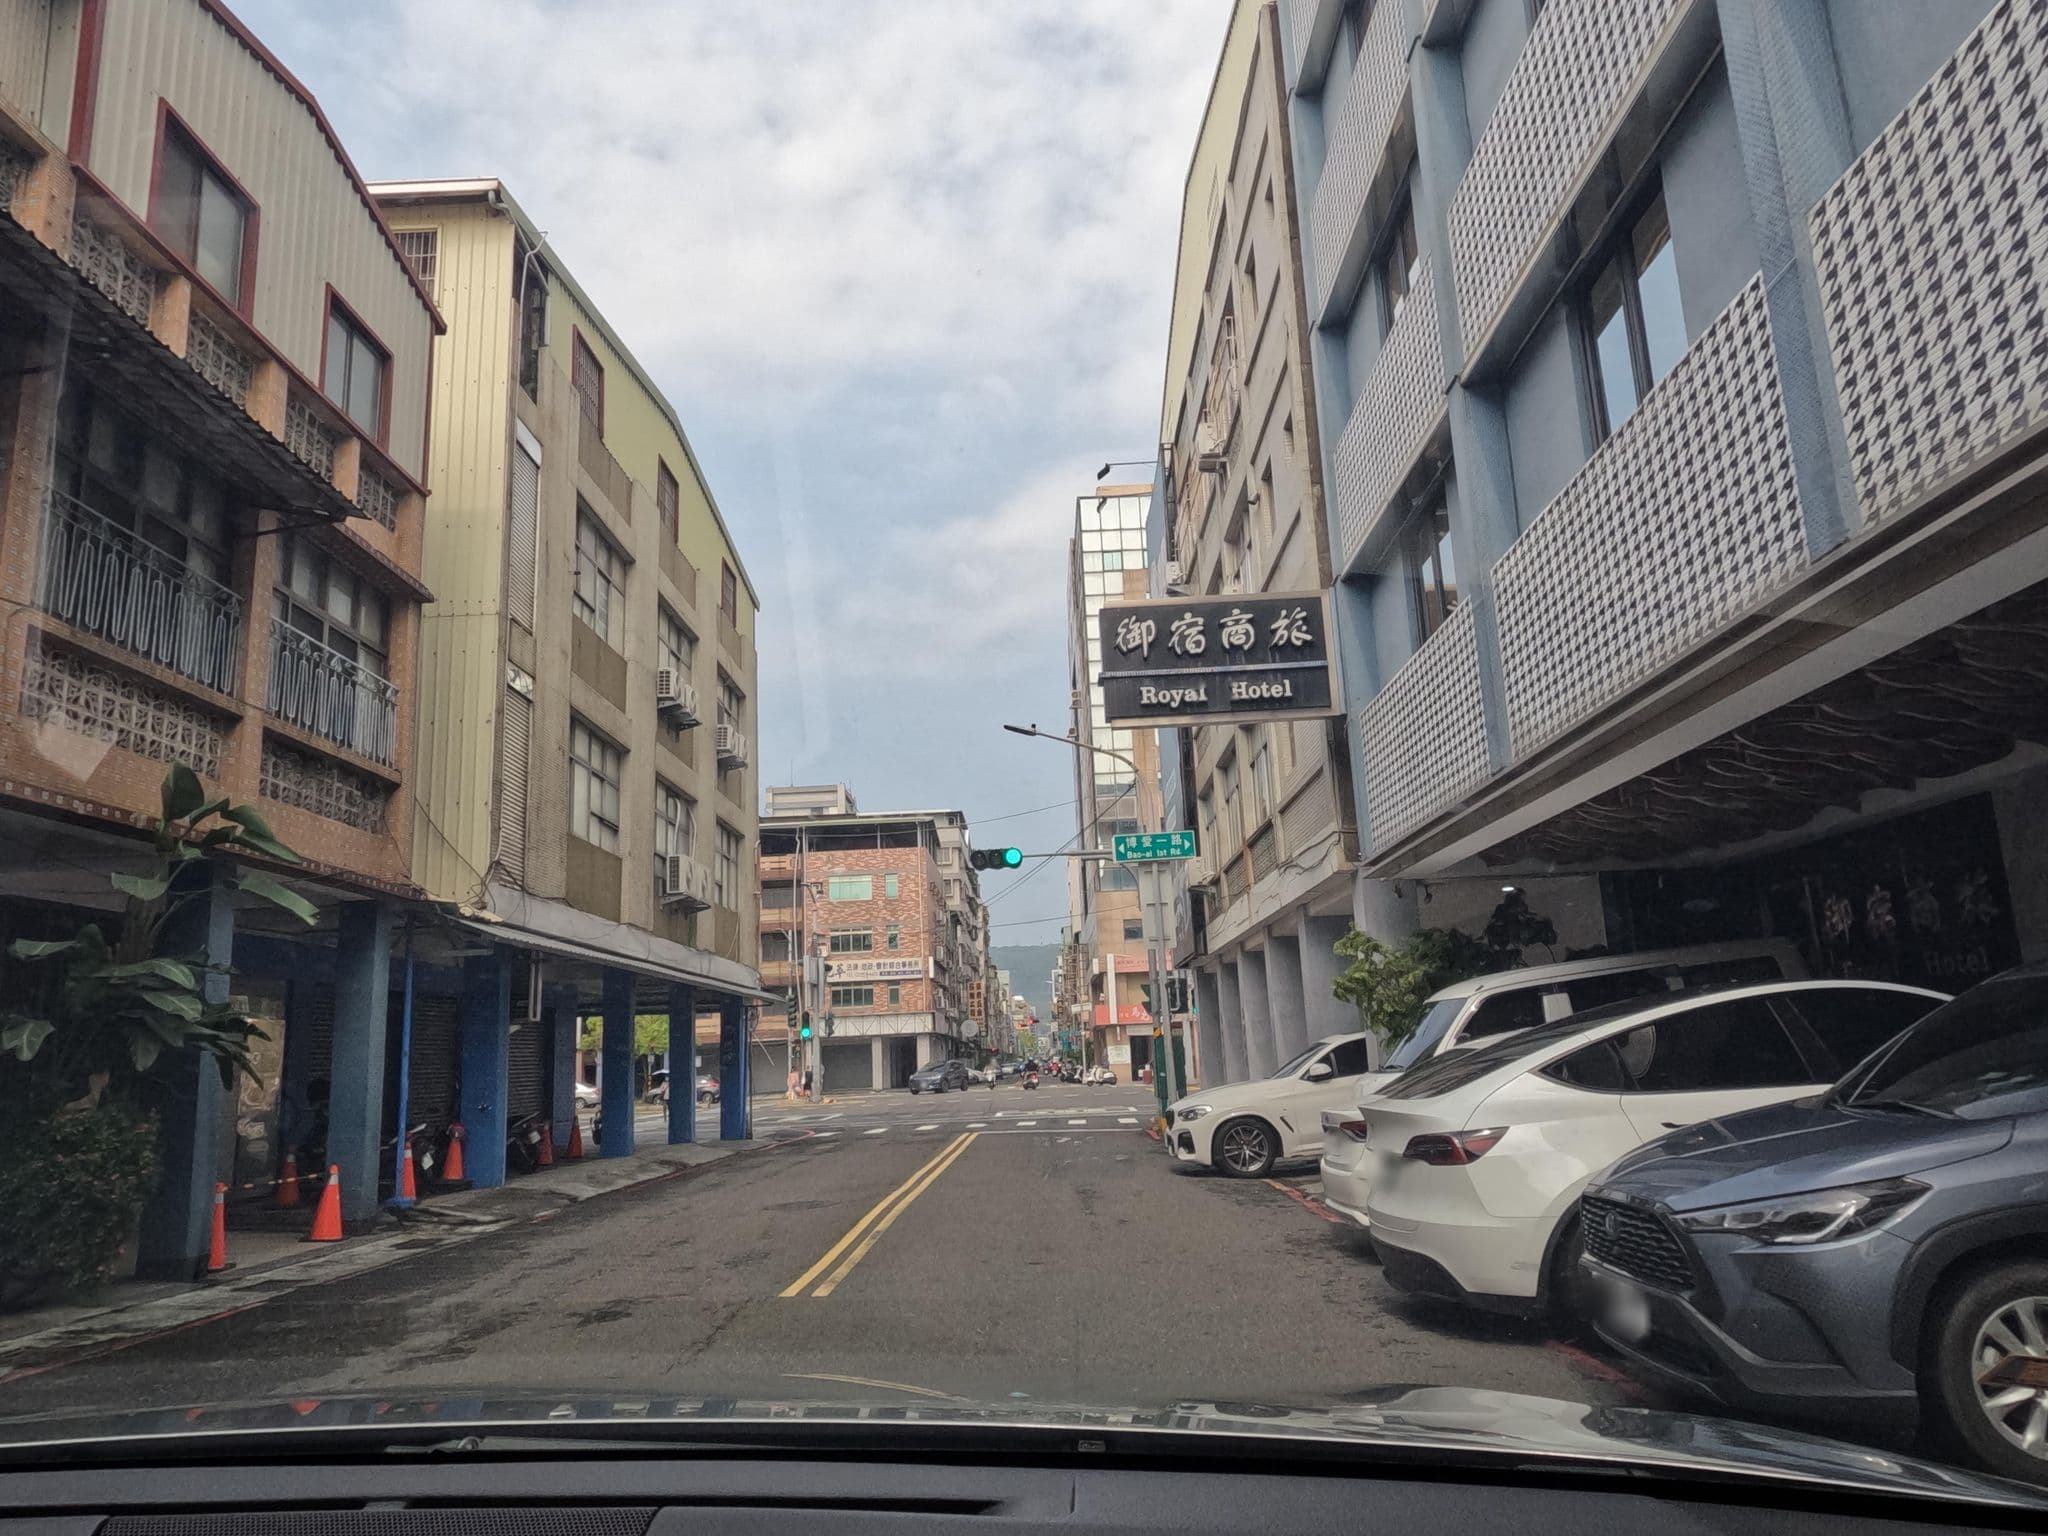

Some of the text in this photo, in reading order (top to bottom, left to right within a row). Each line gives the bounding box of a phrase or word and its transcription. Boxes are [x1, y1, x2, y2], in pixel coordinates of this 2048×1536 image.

[1115, 606, 1313, 658] 御宿商旅
[1140, 679, 1293, 708] Royal Hotel
[1126, 834, 1182, 848] 博愛一路
